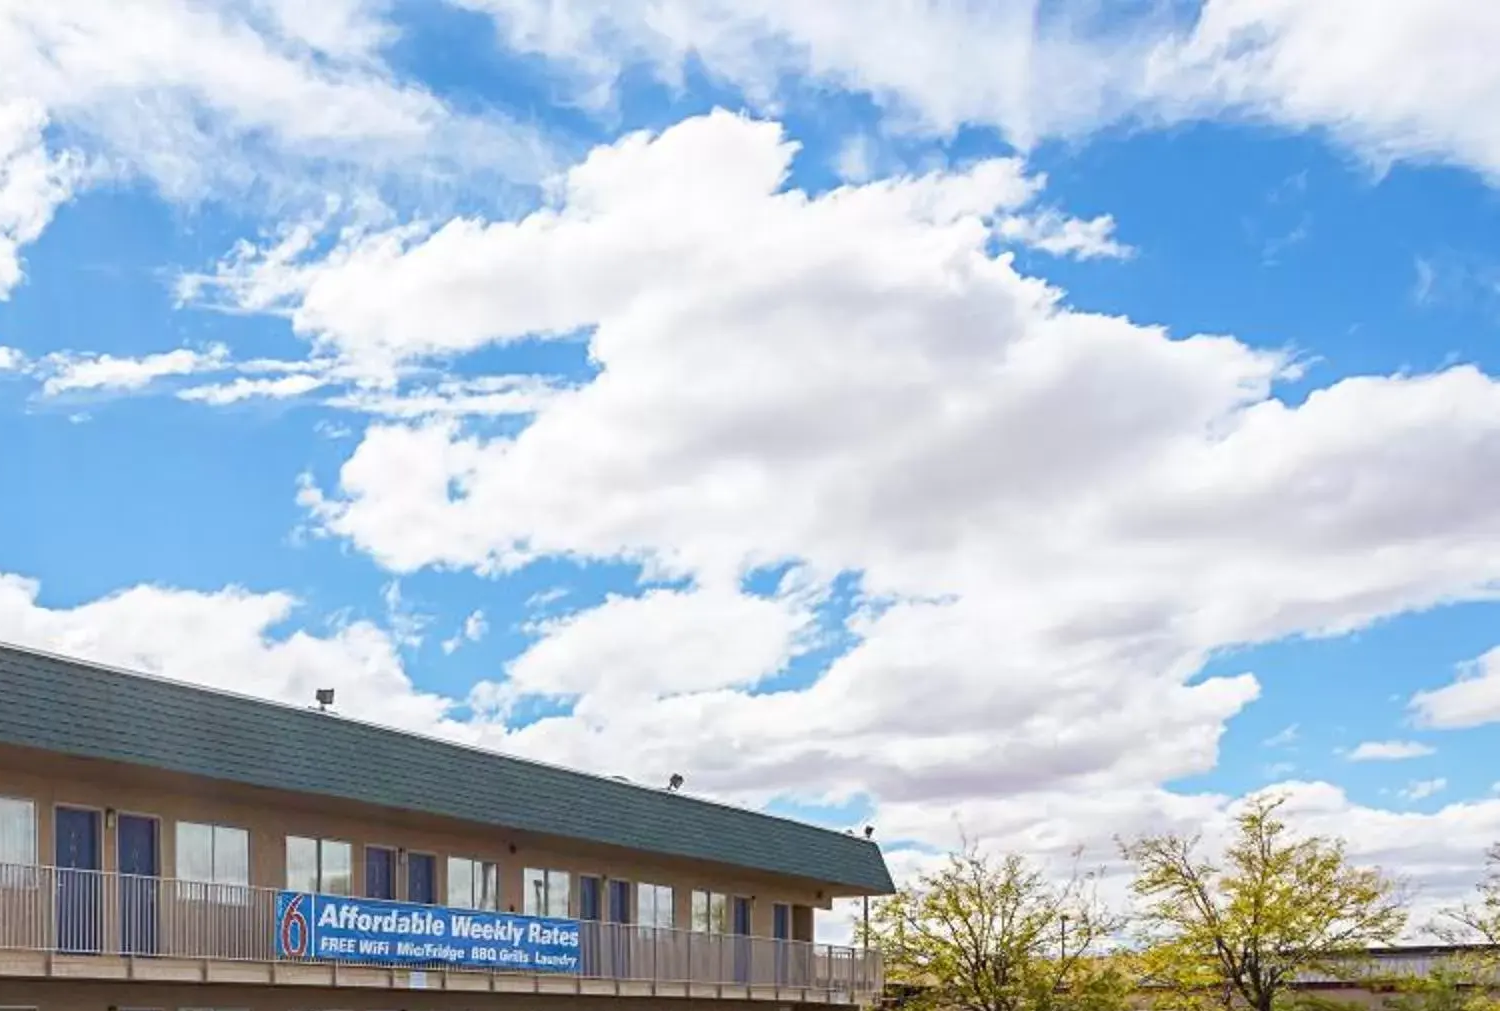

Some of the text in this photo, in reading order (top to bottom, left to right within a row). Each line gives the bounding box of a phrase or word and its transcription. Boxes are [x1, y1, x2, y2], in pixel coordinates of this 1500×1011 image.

[317, 903, 445, 937] Affordable
[451, 914, 525, 947] Weekly
[527, 921, 579, 948] Rates
[320, 935, 356, 953] FREE
[359, 938, 390, 955] WiFi
[471, 946, 497, 961] BBQ
[499, 948, 530, 963] Grills
[534, 951, 578, 969] Laundry
